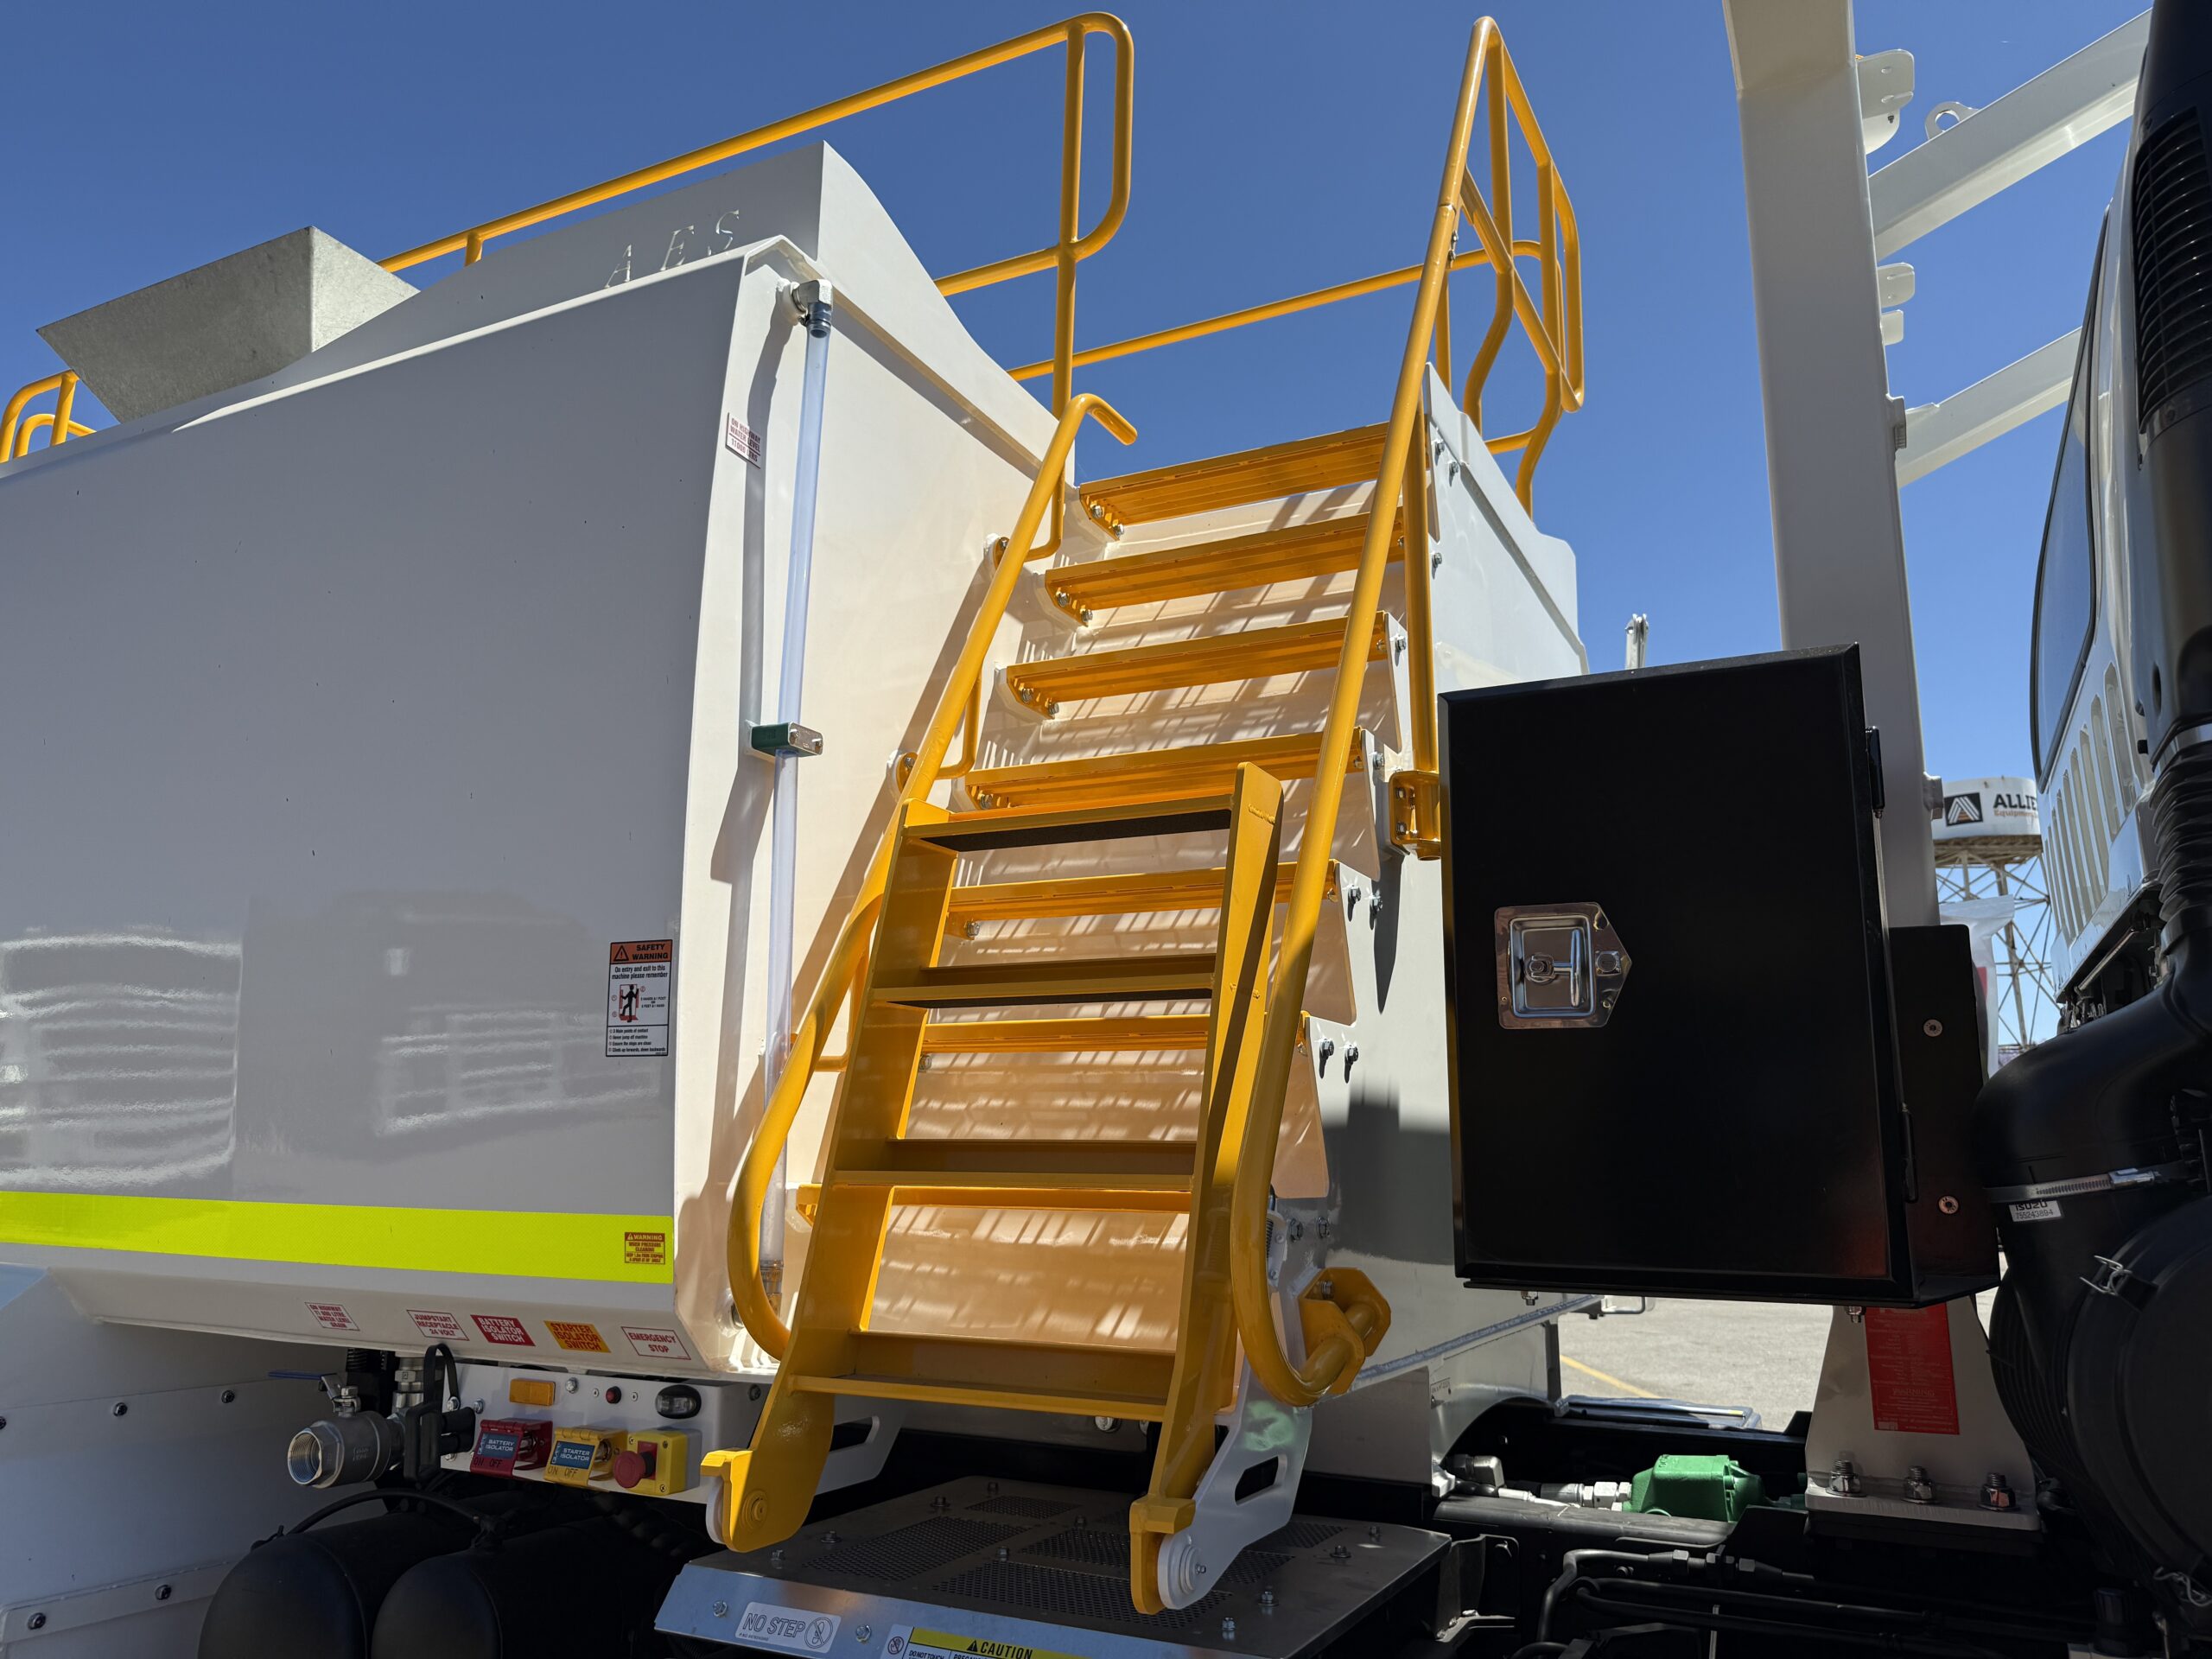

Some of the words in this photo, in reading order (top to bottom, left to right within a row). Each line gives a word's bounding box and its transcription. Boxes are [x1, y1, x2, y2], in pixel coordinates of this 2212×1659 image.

[730, 425, 746, 442] WATER
[414, 1313, 453, 1323] JUMPSTART
[477, 1317, 516, 1327] BATTERY
[416, 1321, 460, 1330] RECEPTACLE
[481, 1325, 524, 1335] ISOLATOR
[550, 1323, 594, 1334] STARTER
[490, 1332, 525, 1343] SWITCH
[553, 1332, 601, 1343] ISOLATOR
[627, 1332, 677, 1344] EMERGENCY
[564, 1340, 602, 1351] SWITCH
[648, 1344, 670, 1353] STOP
[563, 1447, 590, 1456] STARTER
[489, 1458, 504, 1468] OFF
[564, 1467, 579, 1478] OFF
[742, 1612, 767, 1632] NO
[767, 1617, 806, 1638] STEP
[980, 1643, 1033, 1659] CAUTION
